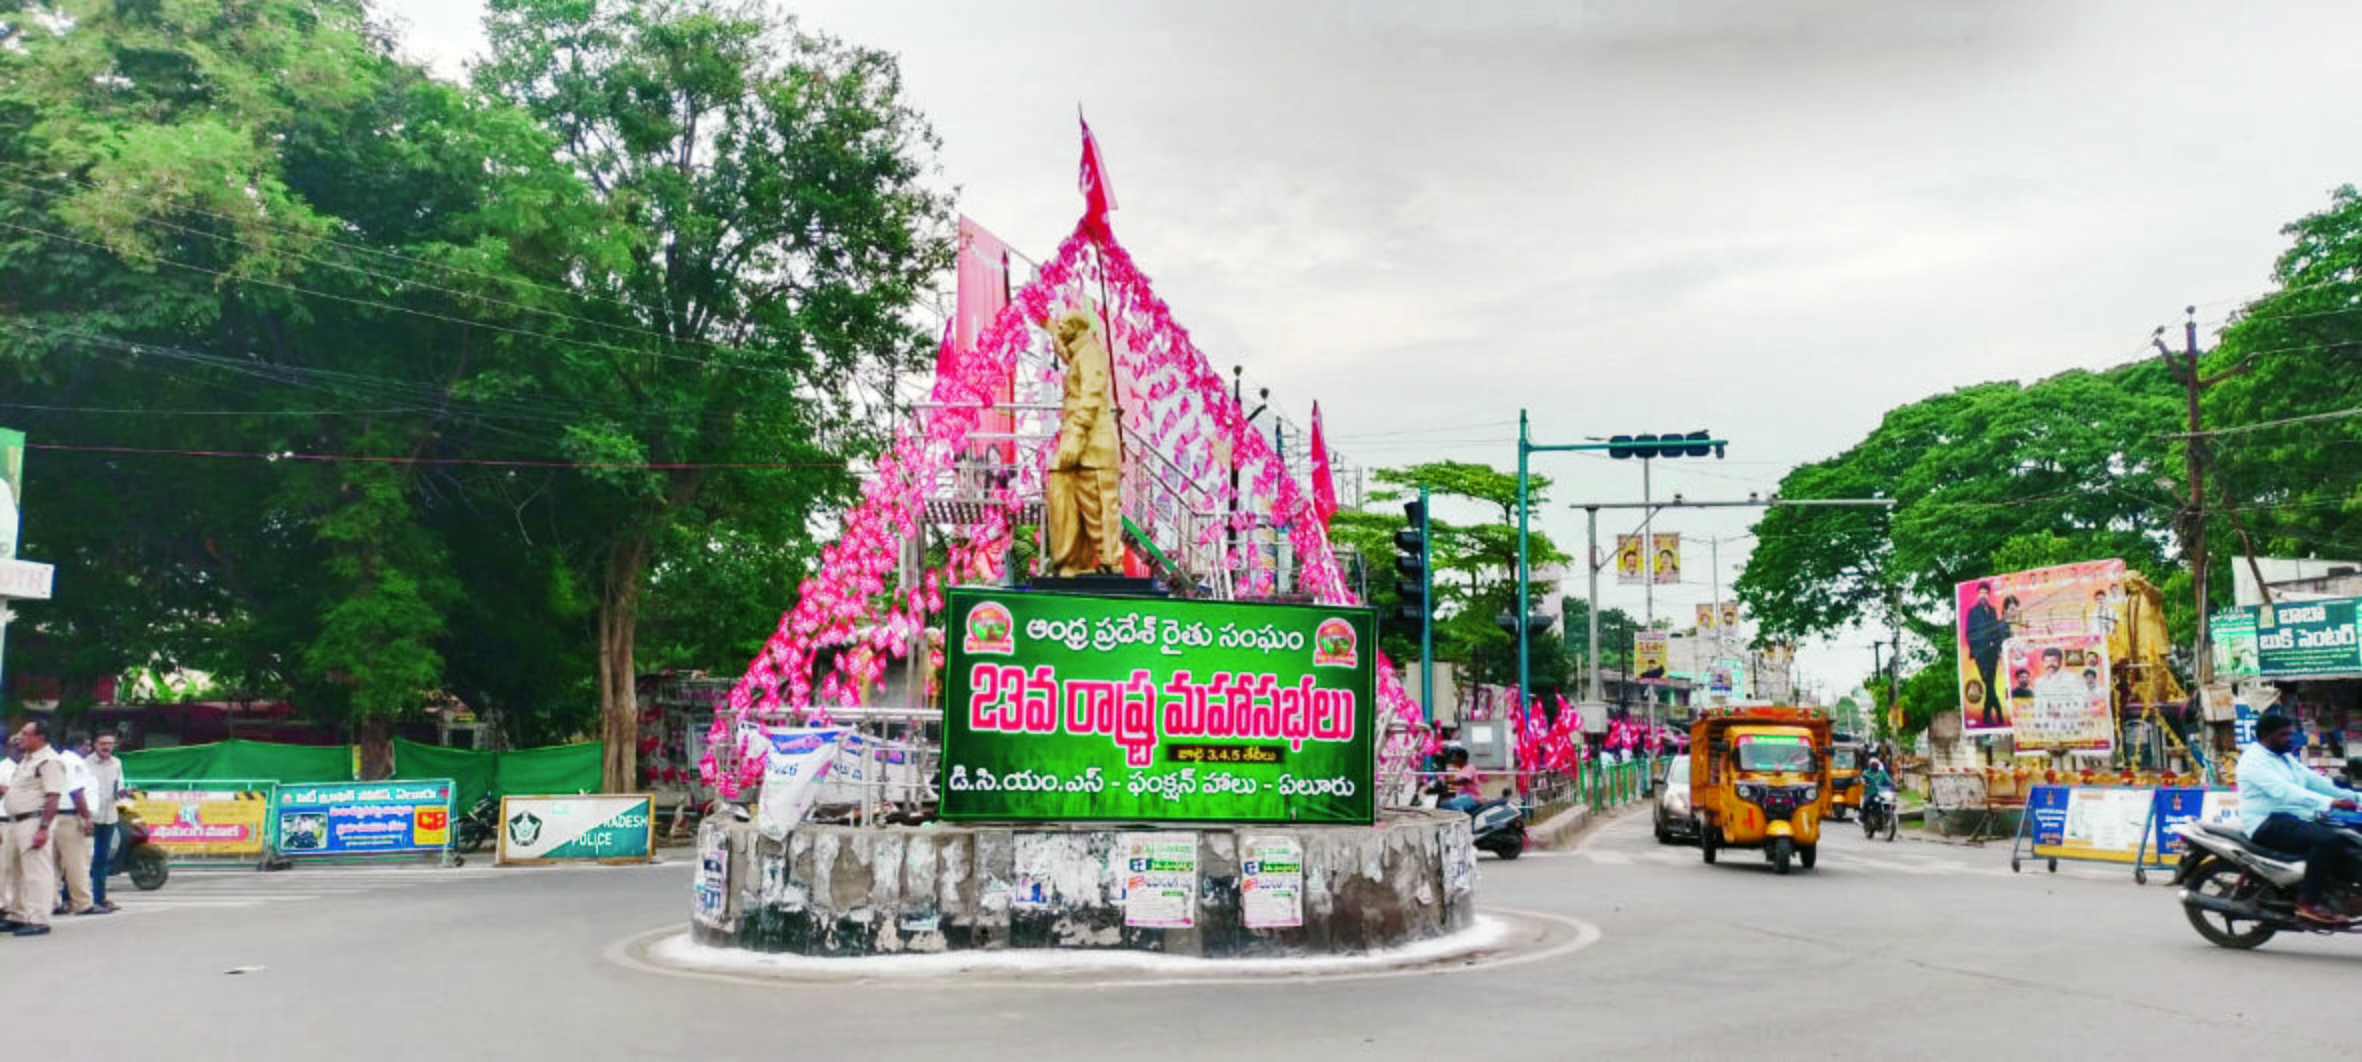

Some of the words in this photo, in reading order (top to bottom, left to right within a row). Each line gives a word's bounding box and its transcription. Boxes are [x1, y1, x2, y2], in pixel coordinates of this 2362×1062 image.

[2278, 606, 2326, 625] బాబా
[1026, 617, 1090, 651] ఆంధ్ర
[1093, 613, 1157, 652] ప్రదేశ్
[1161, 619, 1213, 656] రైతు
[1219, 625, 1305, 654] సంఘం
[2259, 627, 2294, 649] బుక్
[2296, 623, 2356, 648] సెంటర్
[968, 662, 1058, 735] 23వ
[1064, 667, 1158, 768] రాష్ట్ర
[1163, 669, 1356, 753] మహాసభలు
[1127, 768, 1196, 802] ఫంక్షన్
[1202, 773, 1256, 795] హాలు
[1278, 774, 1355, 798] ఏలూరు
[600, 814, 648, 829] RADESH
